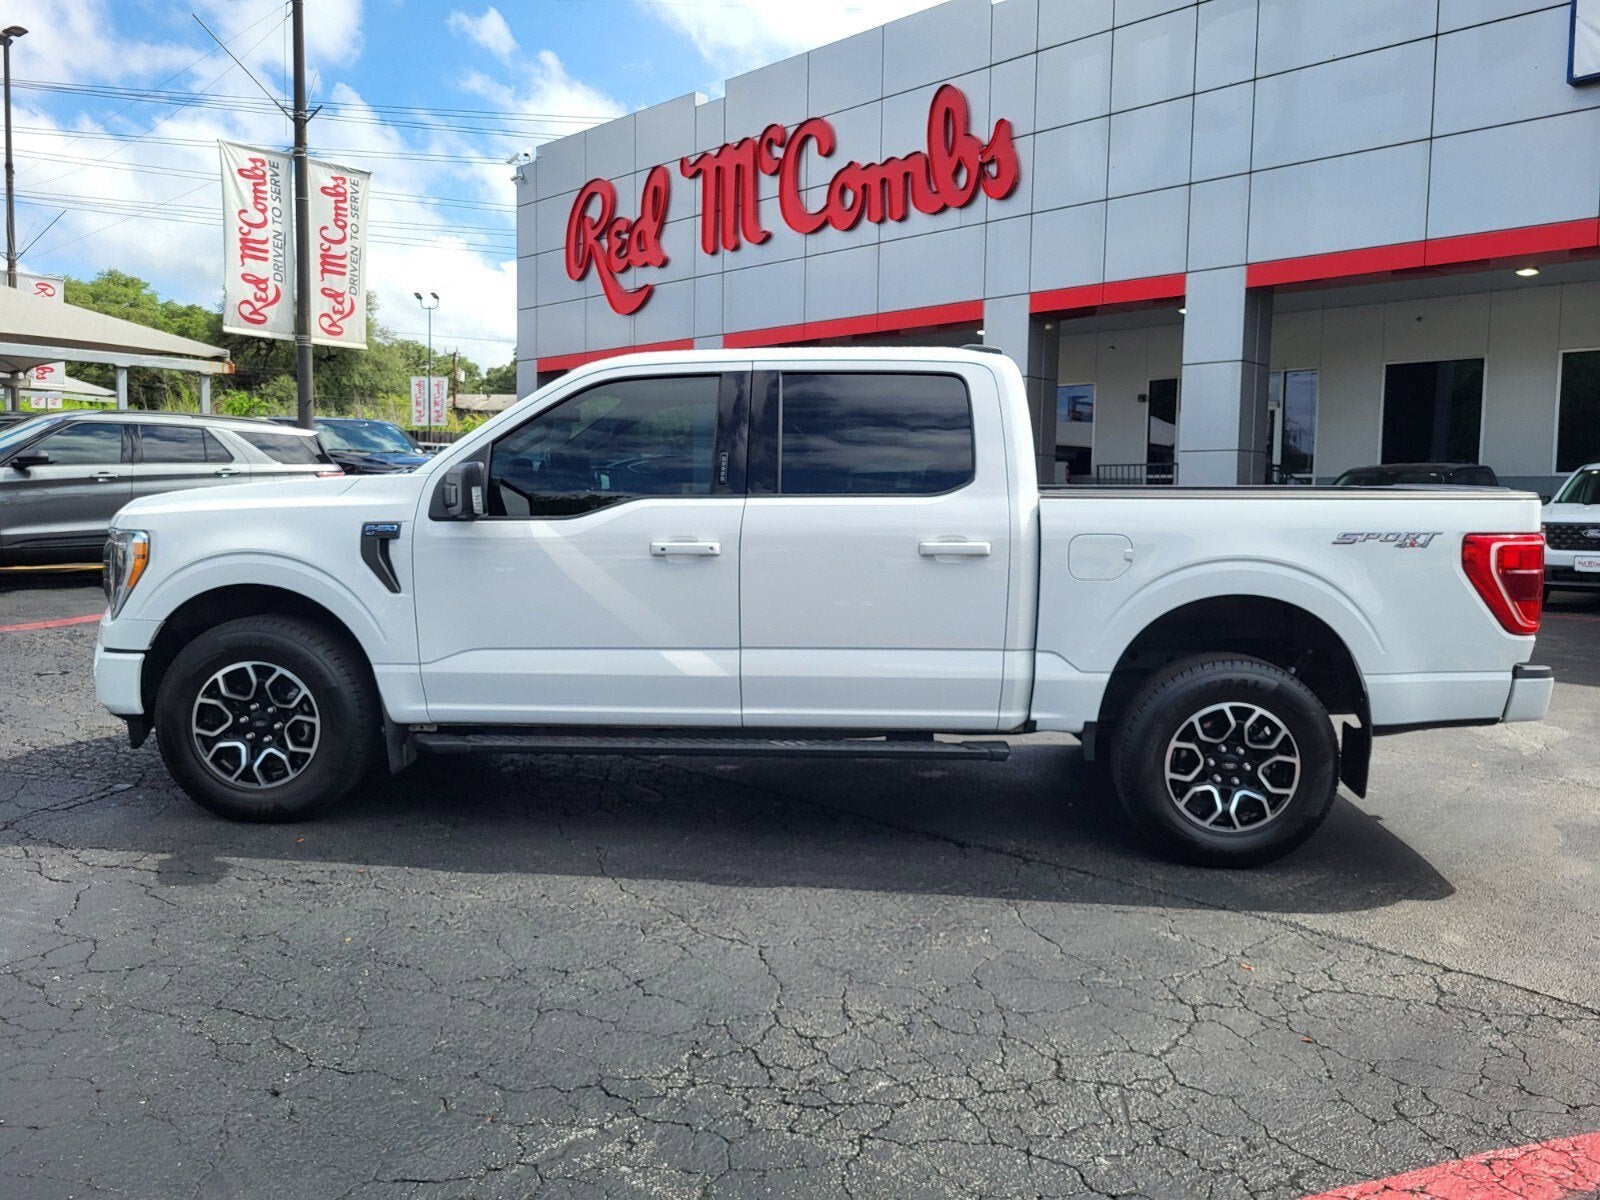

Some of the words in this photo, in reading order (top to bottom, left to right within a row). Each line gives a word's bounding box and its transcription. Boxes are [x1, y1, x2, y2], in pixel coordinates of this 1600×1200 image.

[269, 159, 282, 205] SERVE
[349, 178, 360, 223] SERVE
[565, 165, 669, 315] Red
[680, 84, 1020, 255] McCombs
[238, 158, 269, 267] McCombs
[271, 206, 283, 228] TO
[319, 175, 349, 282] McCombs
[349, 224, 360, 241] TO
[271, 230, 284, 283] DRIVEN
[349, 245, 360, 296] DRIVEN
[238, 273, 281, 325] Red
[318, 286, 355, 337] Red
[1331, 531, 1444, 549] SPORT
